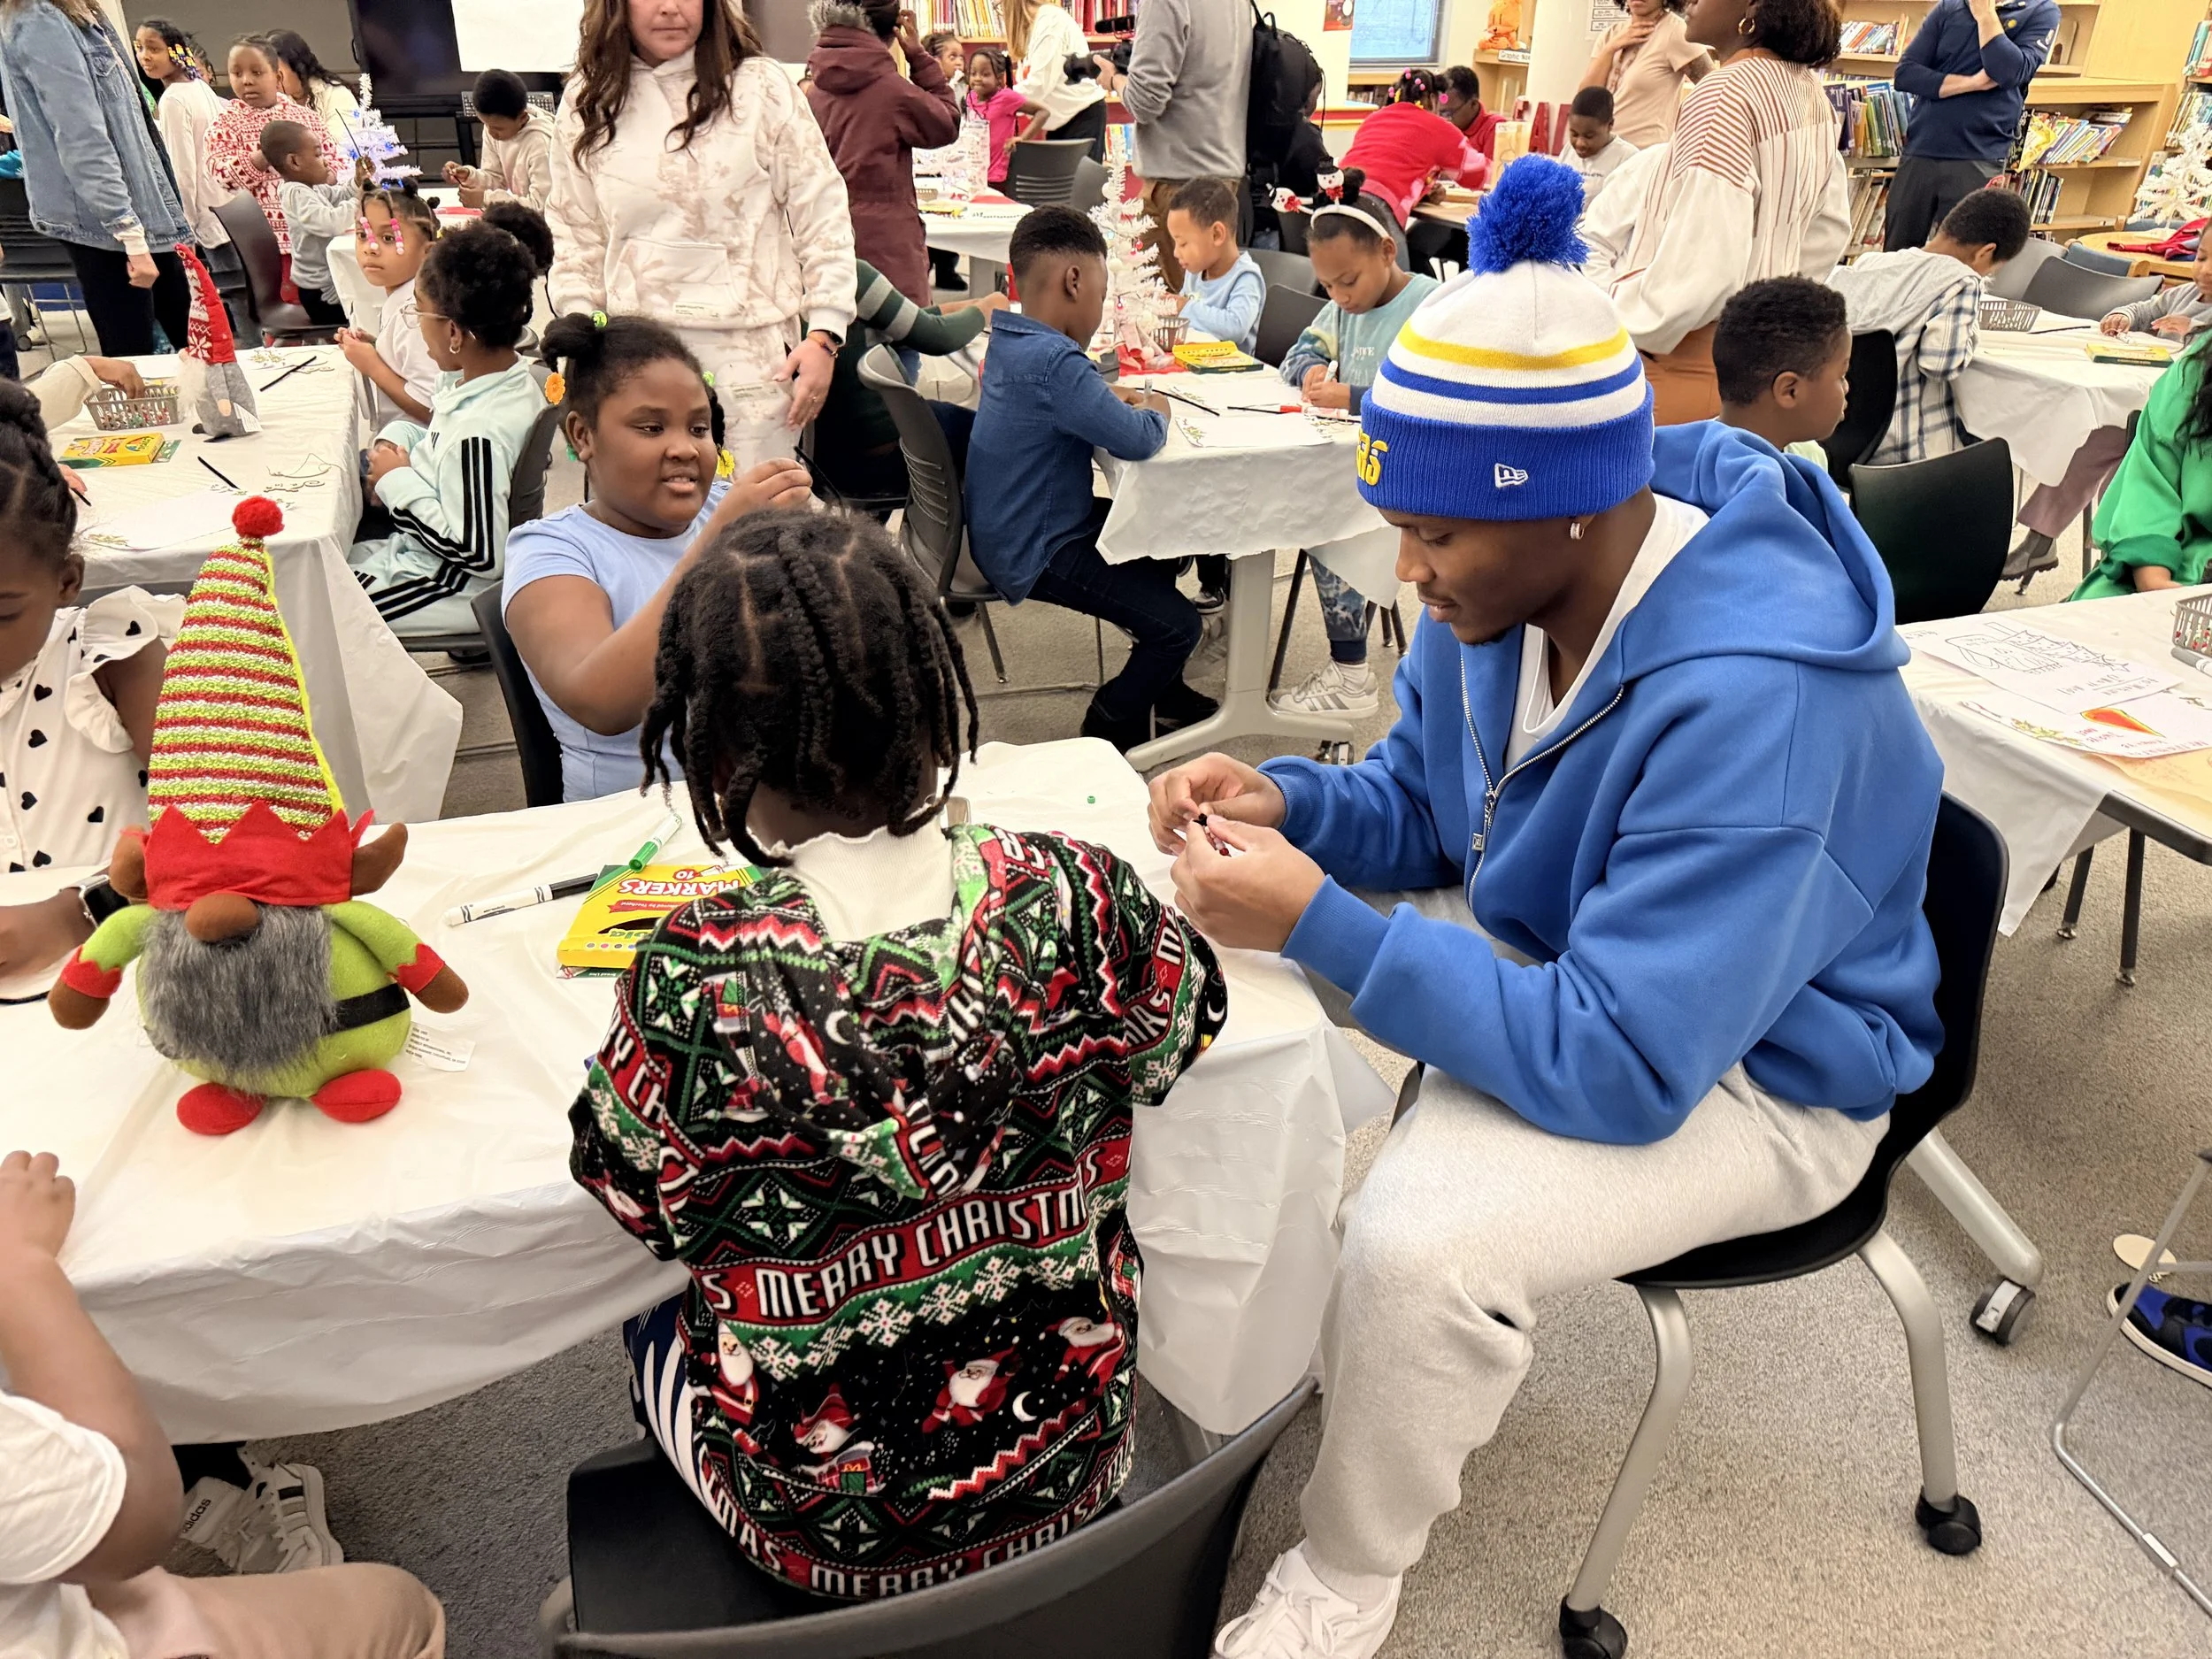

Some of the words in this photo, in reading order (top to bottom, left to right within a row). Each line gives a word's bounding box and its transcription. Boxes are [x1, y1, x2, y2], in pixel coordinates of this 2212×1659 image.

[676, 870, 695, 879] 10
[618, 879, 741, 895] MARKERS
[755, 1230, 908, 1318] MERRY
